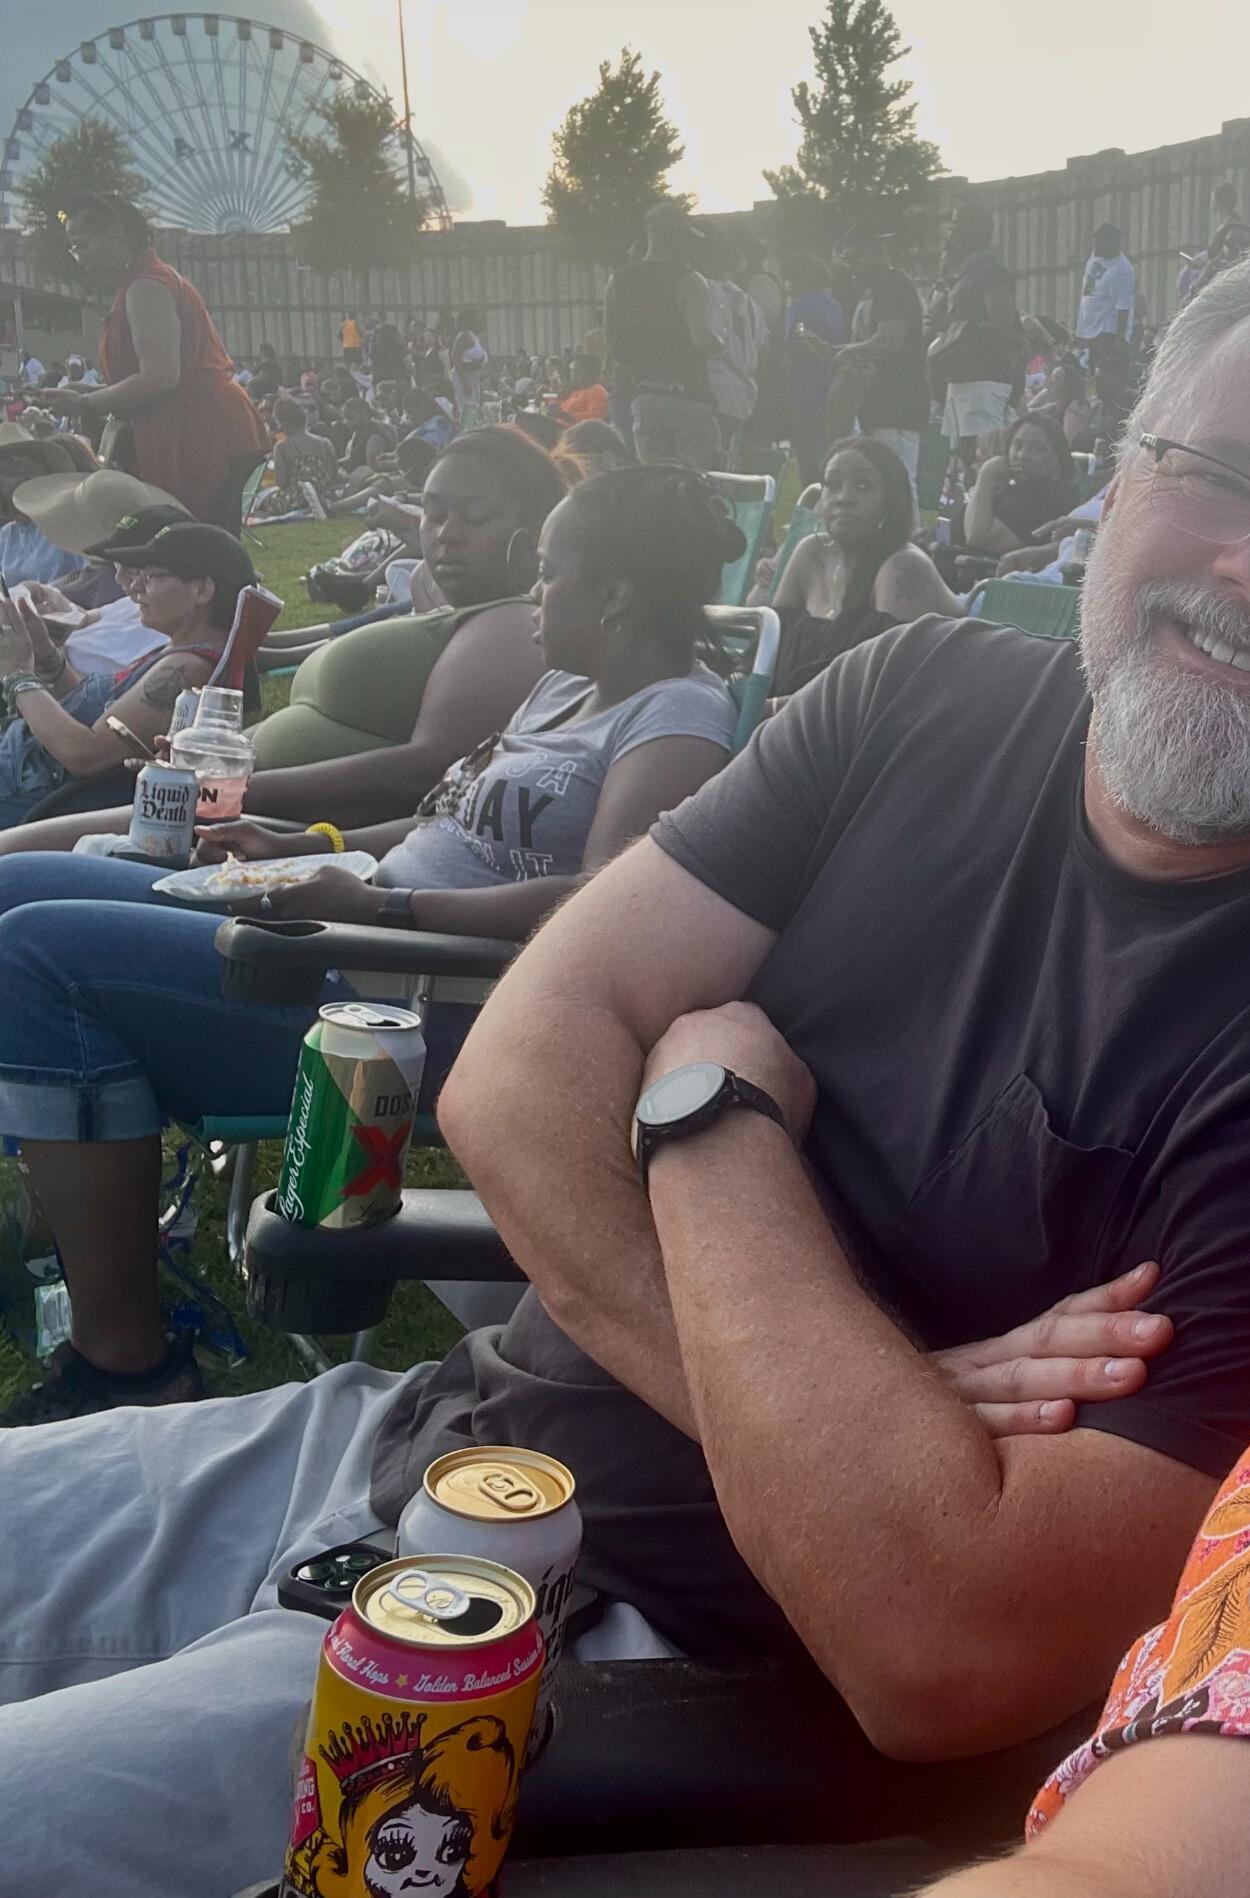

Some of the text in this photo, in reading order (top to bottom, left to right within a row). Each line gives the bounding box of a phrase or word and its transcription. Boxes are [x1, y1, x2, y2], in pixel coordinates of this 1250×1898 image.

[141, 780, 190, 806] Liquid
[141, 800, 187, 823] Death
[279, 1072, 314, 1222] Lager Especial
[336, 1641, 366, 1671] Floral
[360, 1660, 389, 1685] Hops
[412, 1673, 459, 1693] Golden
[461, 1664, 512, 1692] Balanced
[513, 1648, 539, 1676] Session
